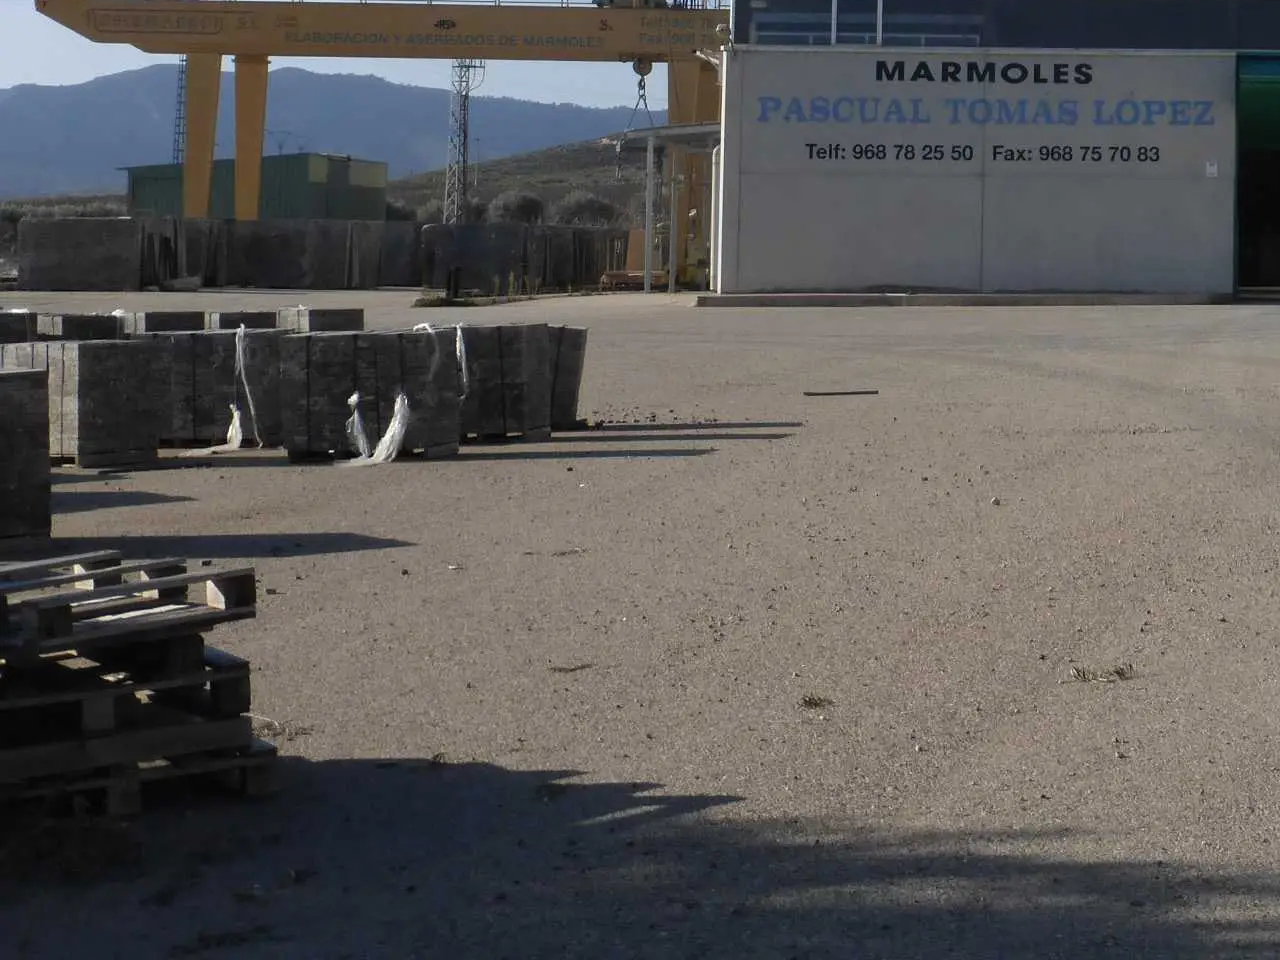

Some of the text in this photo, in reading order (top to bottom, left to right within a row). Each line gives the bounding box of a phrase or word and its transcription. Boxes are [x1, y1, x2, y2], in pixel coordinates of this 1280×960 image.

[875, 60, 1094, 85] MARMOLES
[756, 95, 932, 124] PASCUAL
[804, 143, 1161, 163] Telf: 968 78 25 50 Fax: 968 75 70 83
